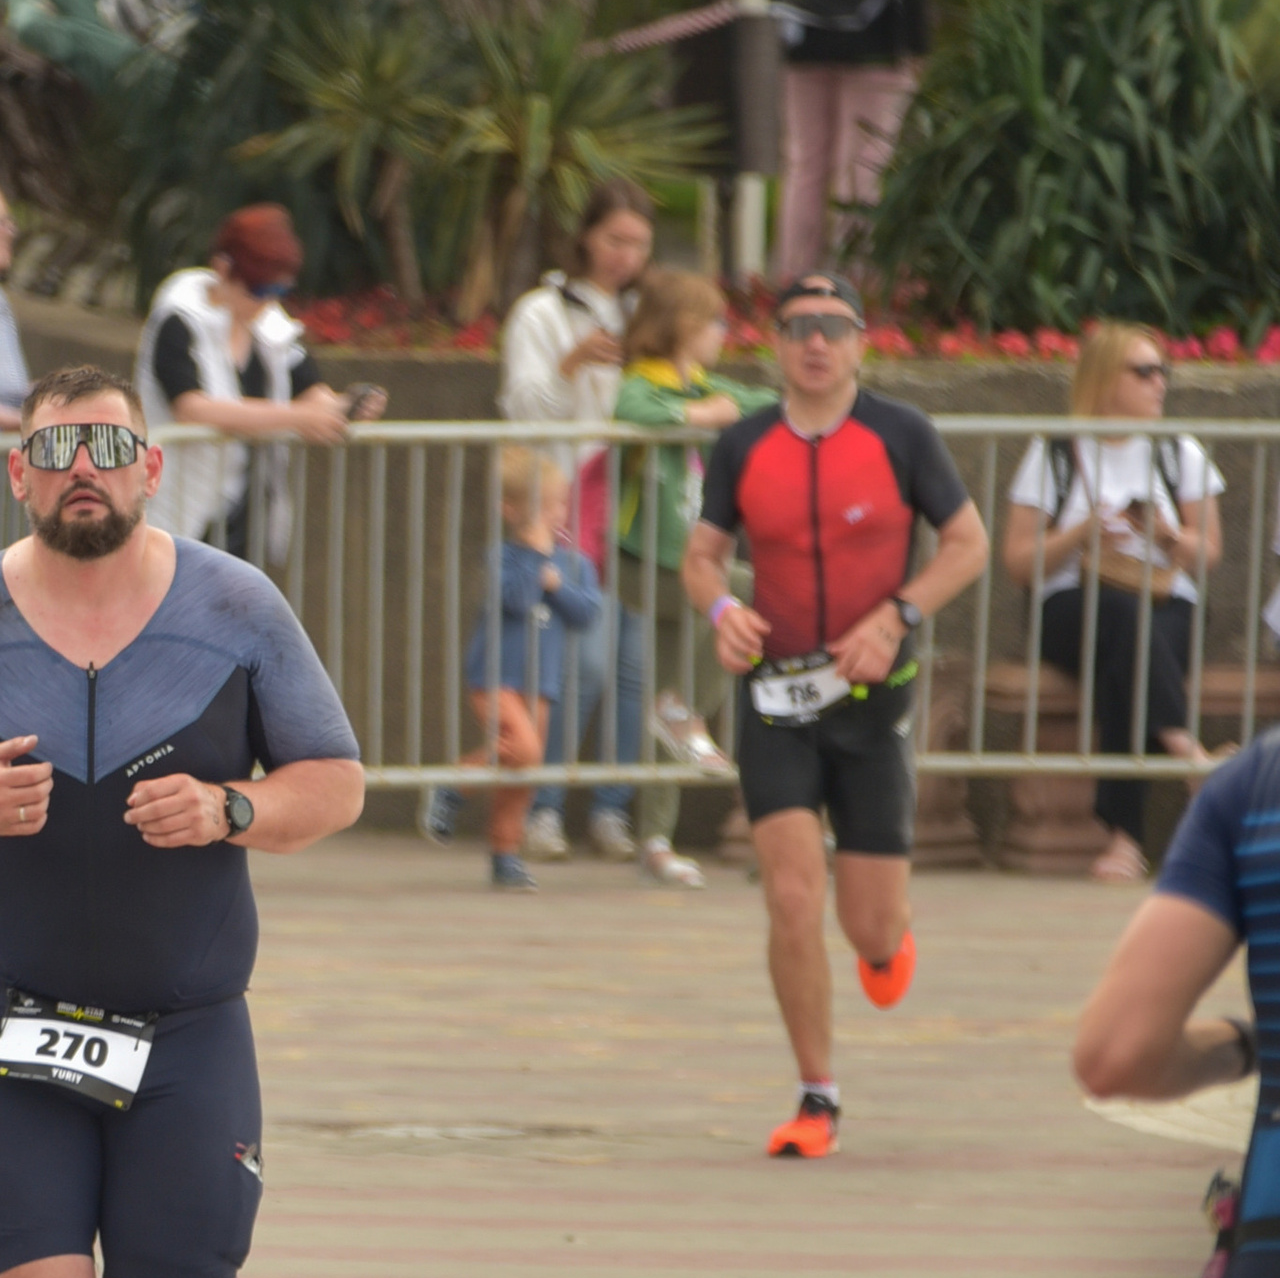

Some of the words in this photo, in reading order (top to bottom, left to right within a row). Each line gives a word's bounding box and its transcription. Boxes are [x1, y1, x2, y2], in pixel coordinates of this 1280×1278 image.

[126, 743, 174, 778] APTONIA
[35, 1028, 109, 1068] 270
[51, 1067, 83, 1084] YURIY
